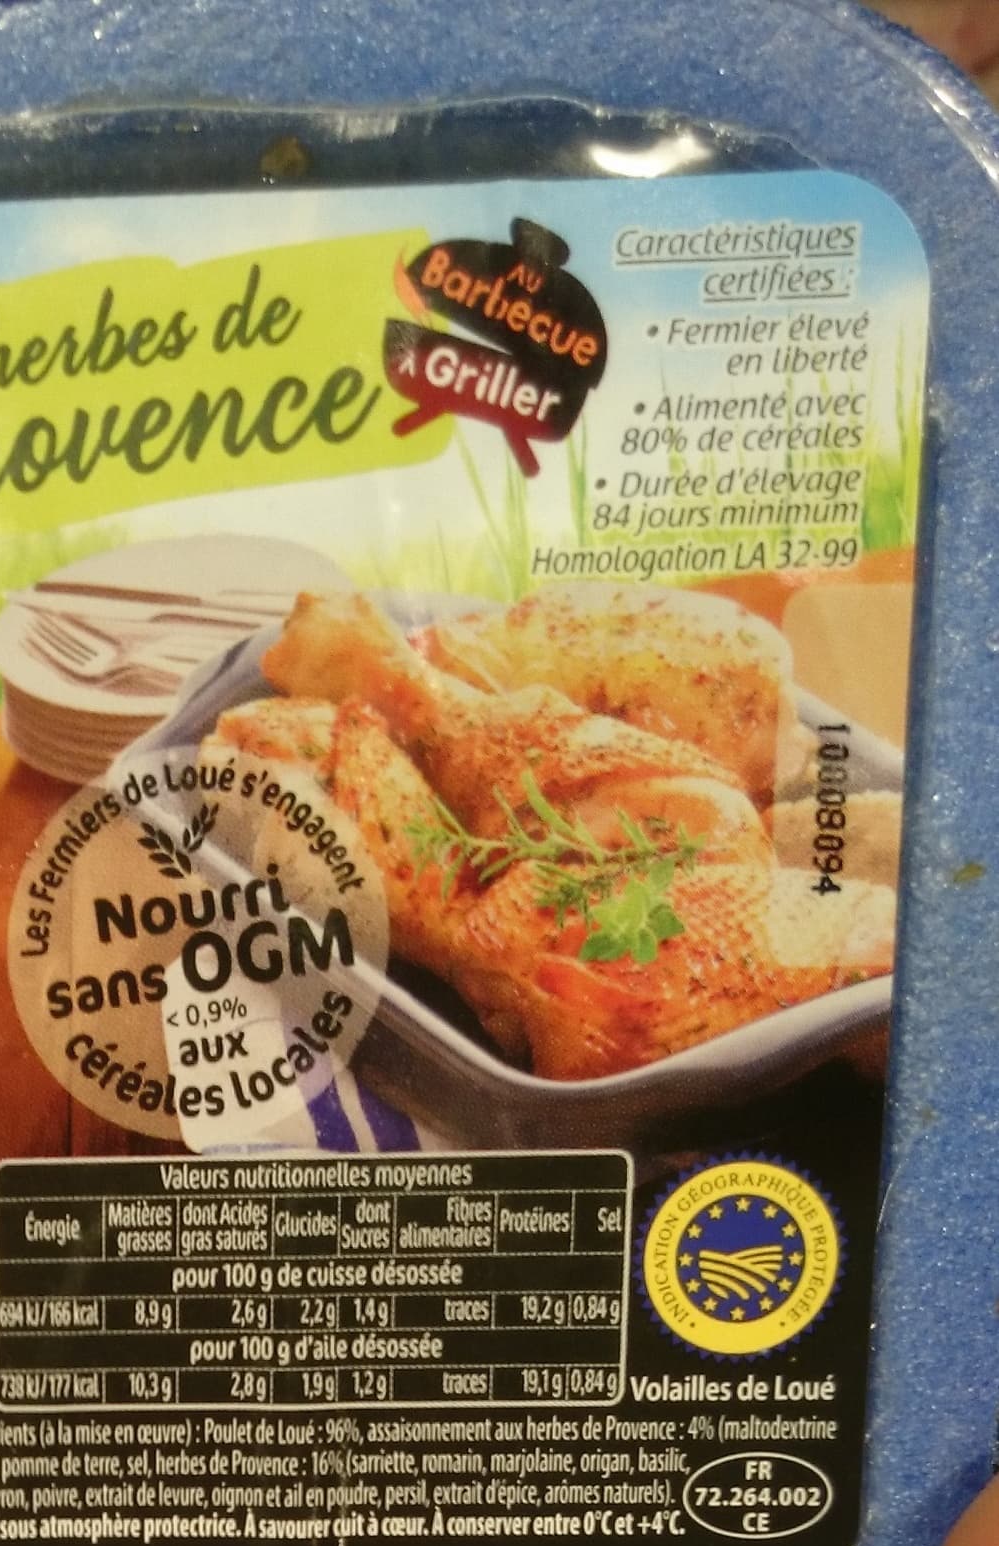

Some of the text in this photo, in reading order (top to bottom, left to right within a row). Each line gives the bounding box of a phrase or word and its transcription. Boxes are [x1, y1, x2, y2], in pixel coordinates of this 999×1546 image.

[616, 225, 857, 257] Caractéristiques
[703, 263, 835, 300] certifiées
[213, 263, 302, 353] de
[422, 249, 598, 366] Barbecue
[668, 311, 870, 345] Fermier élevé
[727, 344, 868, 376] en liberté
[425, 347, 560, 421] Griller
[653, 392, 866, 422] Alimenté avec
[621, 425, 862, 455] 80% de céréales
[620, 467, 862, 499] Durée d'élevage
[593, 501, 858, 536] 84 jours minimum
[531, 542, 767, 580] Homologation LA
[811, 724, 851, 896] 10008094
[21, 757, 365, 957] Les Fermiers de Loué s'engagent
[94, 863, 289, 943] Nourri
[46, 907, 354, 1020] sans OGM
[185, 996, 249, 1030] 0,9%
[64, 989, 353, 1118] céréales locales
[178, 1030, 250, 1067] aux
[160, 1159, 473, 1191] Valeurs nutritionnelles moyennes
[24, 1211, 81, 1246] Énergie
[108, 1201, 172, 1228] Matières
[275, 1208, 337, 1238] Glucides
[117, 1232, 172, 1256] grasses
[342, 1225, 390, 1249] Sucres
[400, 1223, 492, 1248] alimentaires
[653, 1172, 828, 1324] INDICATION GÉOGRAPHIQUE PROTÉGÉE
[222, 1259, 463, 1287] 100 de cuisse désossée
[444, 1299, 489, 1321] traces
[240, 1336, 274, 1359] 100
[442, 1372, 487, 1394] traces
[630, 1373, 836, 1402] Volailles de Loué
[75, 1419, 112, 1444] mise
[204, 1417, 253, 1444] Poulet
[255, 1418, 274, 1444] de
[278, 1419, 315, 1444] Loué
[367, 1417, 491, 1443] assaisonnement
[526, 1415, 578, 1440] herbes
[605, 1415, 676, 1440] Provence
[718, 1414, 837, 1443] (maltodextrine
[2, 1447, 577, 1484] pomme herbes Provence marjolaine,
[745, 1461, 772, 1480] FR
[85, 1479, 600, 1512] extrait oignon extrait arômes
[694, 1487, 821, 1506] 72.264.002
[0, 1518, 37, 1539] sous
[39, 1512, 140, 1544] atmosphère
[144, 1512, 242, 1544] protectrice.
[259, 1518, 330, 1539] savourer
[447, 1515, 531, 1535] conserver
[533, 1515, 581, 1535] entre
[742, 1513, 770, 1532] CE
